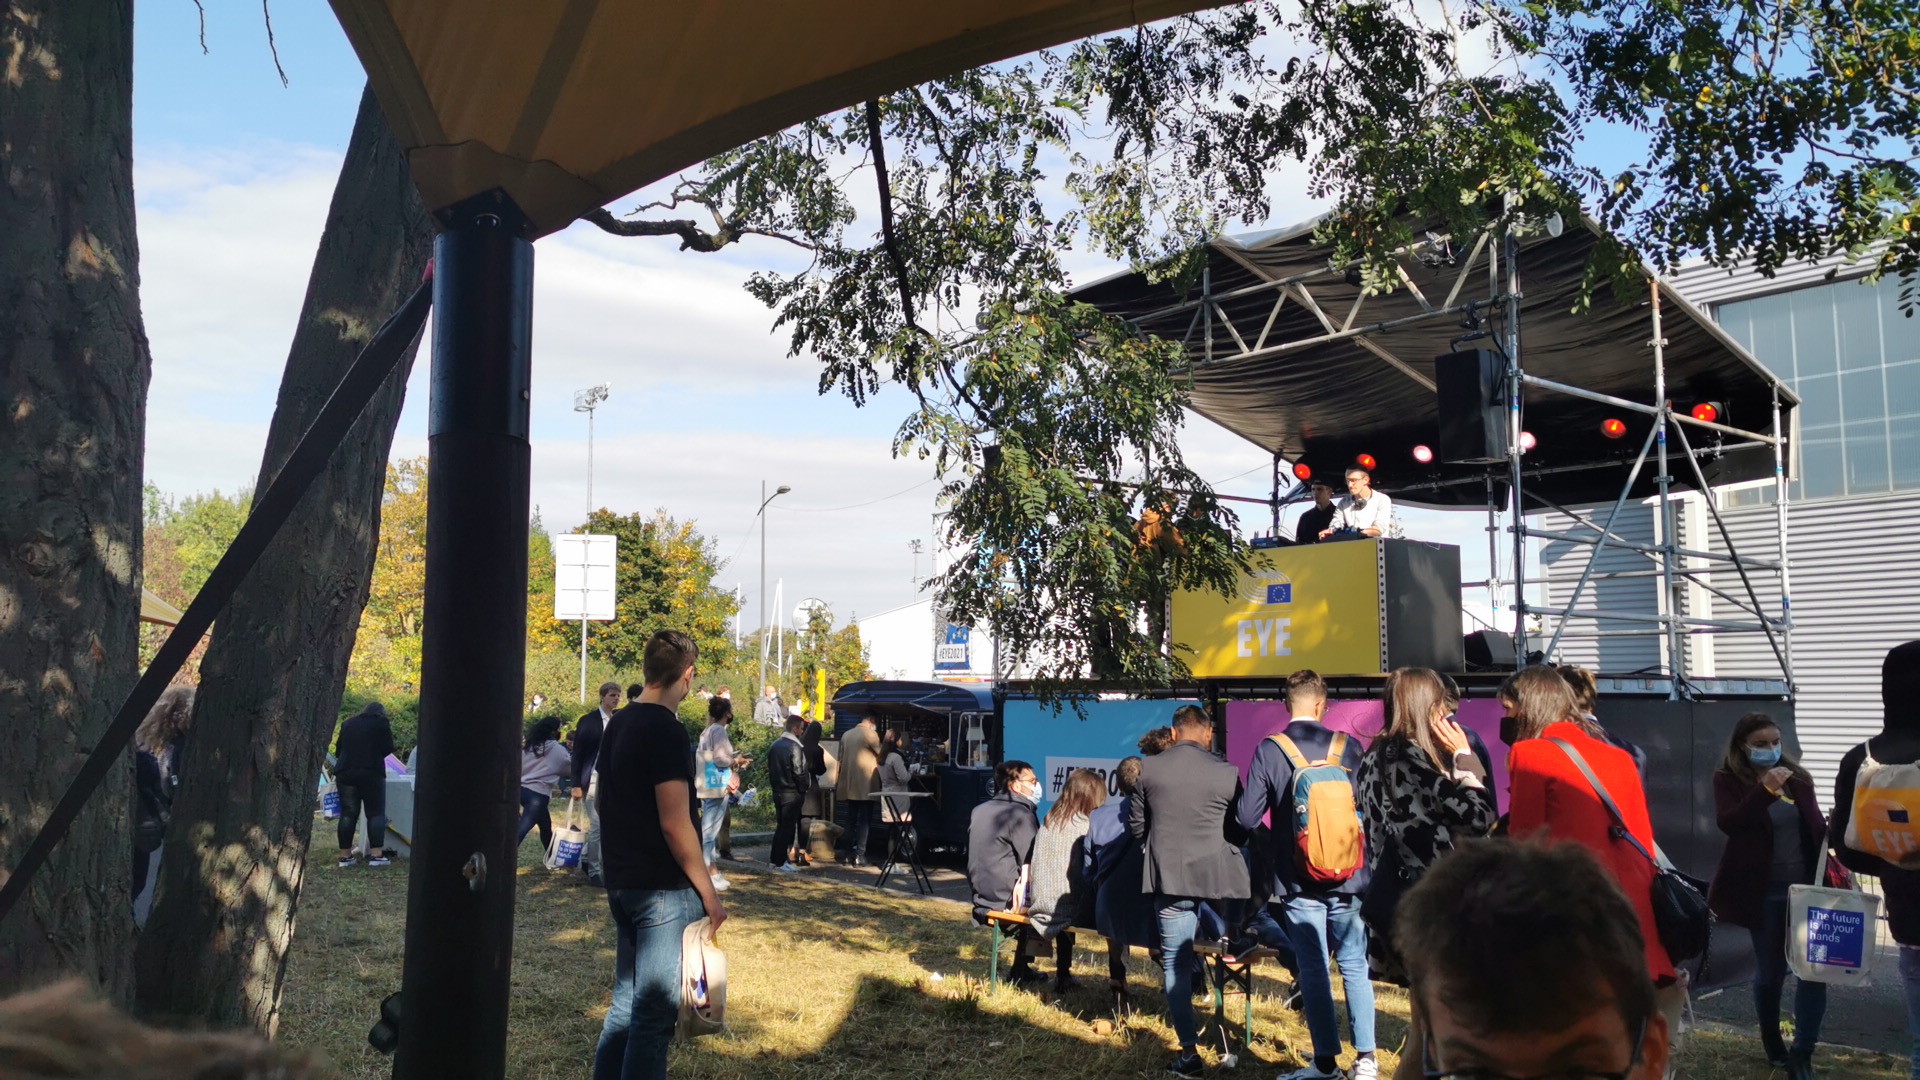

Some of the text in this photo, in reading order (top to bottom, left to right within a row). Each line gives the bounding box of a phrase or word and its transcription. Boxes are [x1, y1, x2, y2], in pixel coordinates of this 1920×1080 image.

[1238, 618, 1292, 657] EYE
[710, 775, 727, 785] EYE
[1810, 909, 1860, 924] The future
[1810, 920, 1854, 936] is in your
[1810, 930, 1840, 943] hands
